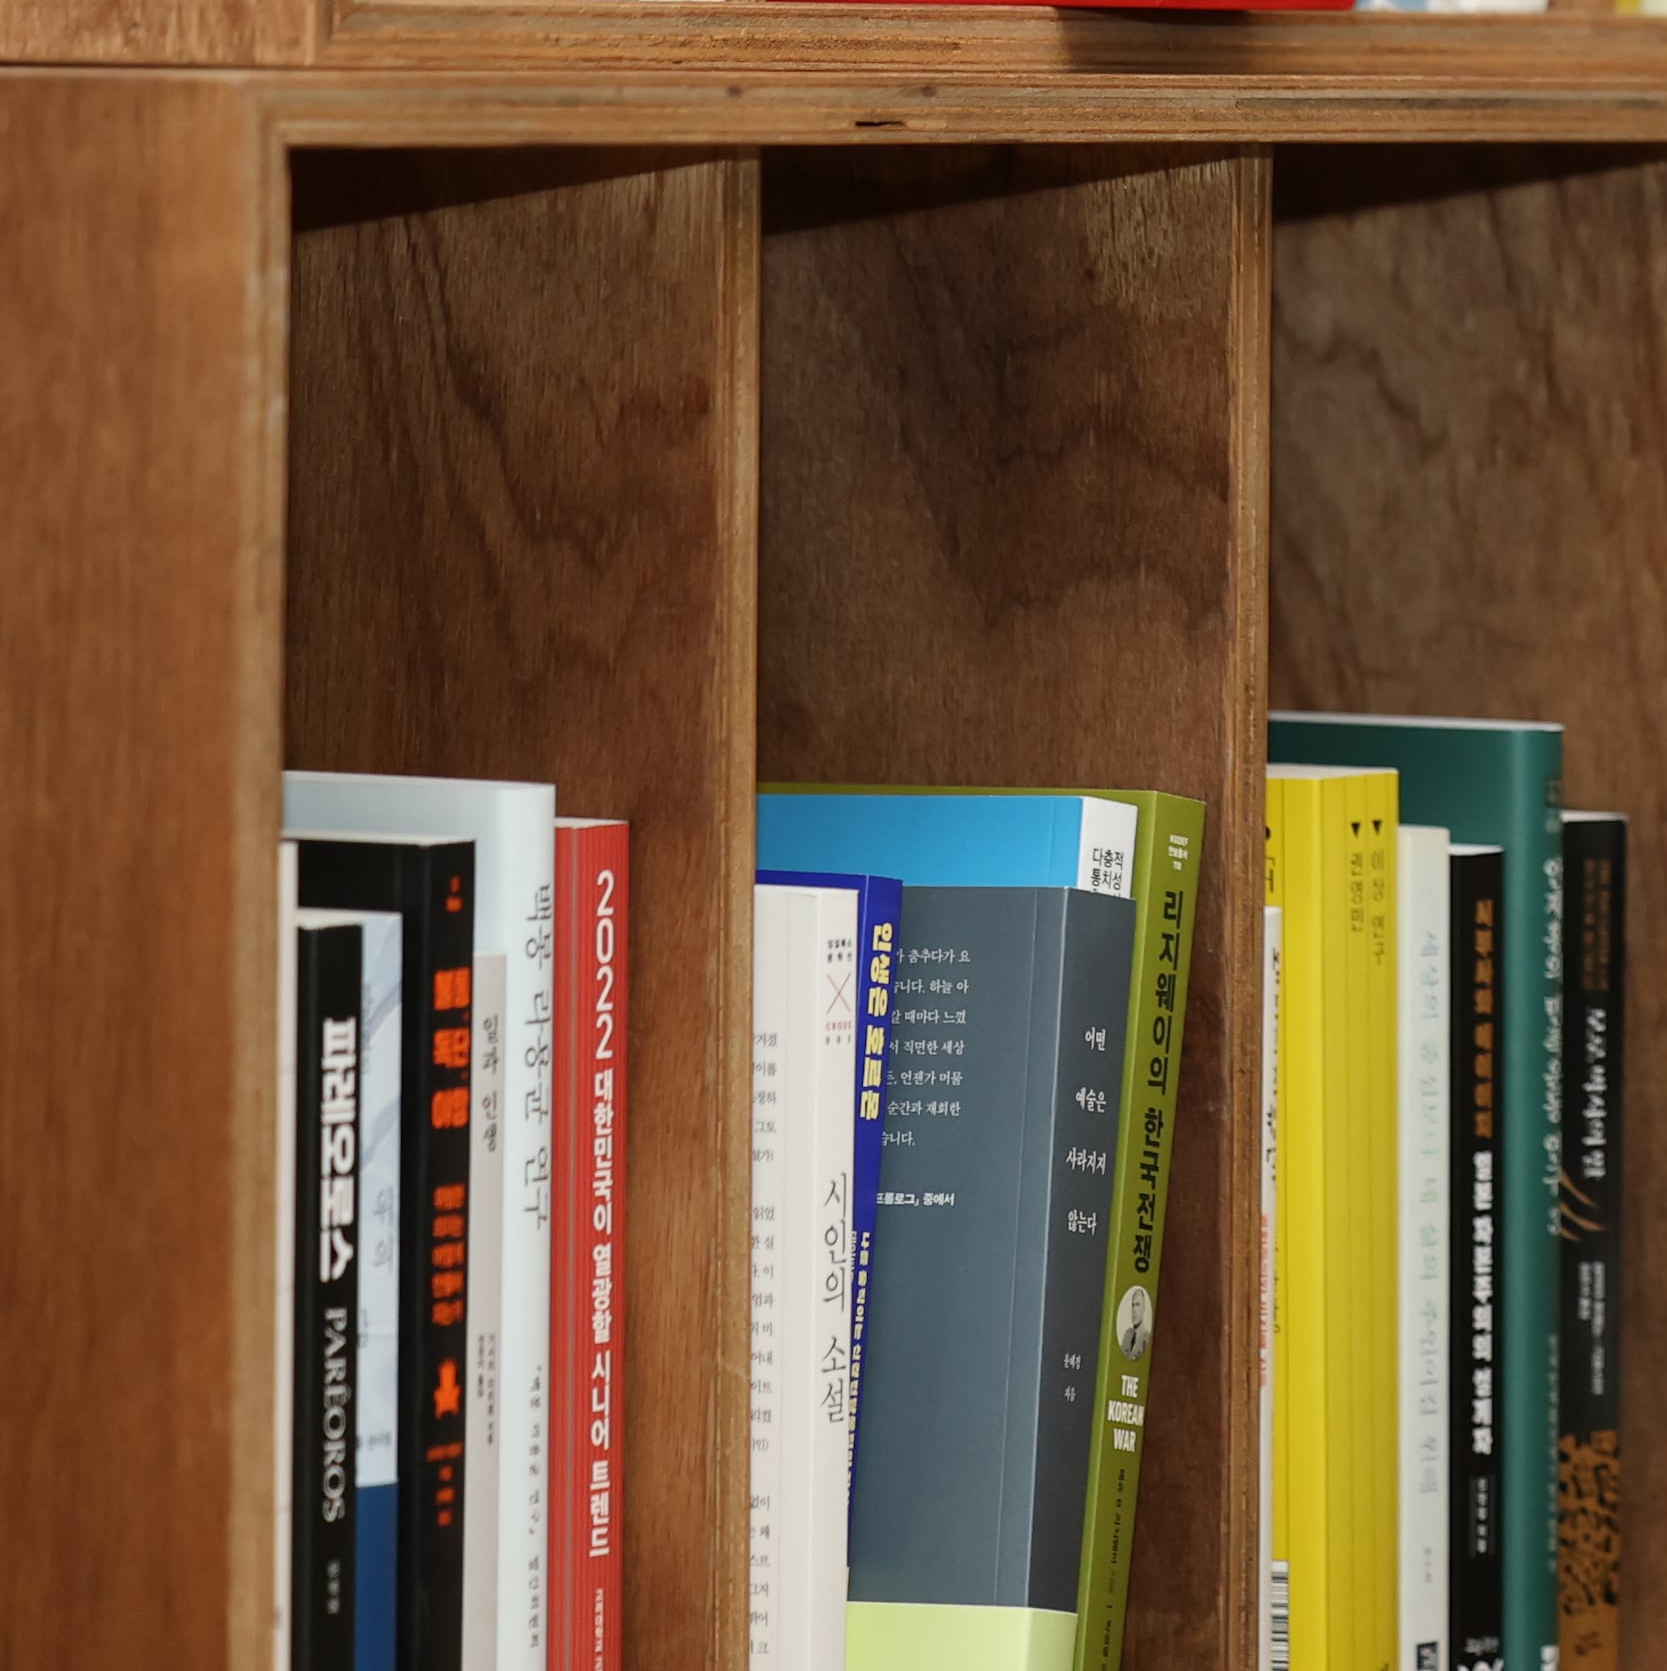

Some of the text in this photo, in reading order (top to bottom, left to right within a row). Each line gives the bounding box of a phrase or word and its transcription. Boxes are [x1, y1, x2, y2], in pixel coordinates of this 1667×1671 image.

[1092, 848, 1124, 870] 다층적
[1091, 868, 1122, 890] 통치성
[908, 948, 955, 964] 춤추다가
[929, 979, 953, 994] 하늘
[956, 979, 969, 994] 아
[860, 922, 893, 1121] 인생은 호르몬
[904, 1009, 940, 1024] 때마다
[903, 1040, 938, 1055] 직면한
[941, 1040, 965, 1055] 세상
[1085, 1027, 1106, 1051] 어떤
[523, 883, 552, 1232] 백봉 라용균 연구
[900, 1070, 936, 1086] 언젠가
[1131, 890, 1184, 1274] 리지웨이의 한국전쟁
[887, 1101, 961, 1117] 순간과 재회한
[1075, 1087, 1107, 1113] 예술은
[321, 1017, 356, 1282] 파레오로스
[1065, 1147, 1106, 1175] 사라지지
[923, 1192, 955, 1207] 중에서
[589, 870, 615, 1558] 2022 대한민국이 열광할 시니어 트렌드
[1067, 1209, 1097, 1235] 않는다
[860, 1231, 870, 1266] 나를
[820, 1172, 848, 1423] 시인의 소설
[854, 1270, 868, 1340] 움직이는
[1121, 1375, 1139, 1398] THE
[1107, 1400, 1145, 1426] KOREAN
[1113, 1428, 1136, 1452] WAR
